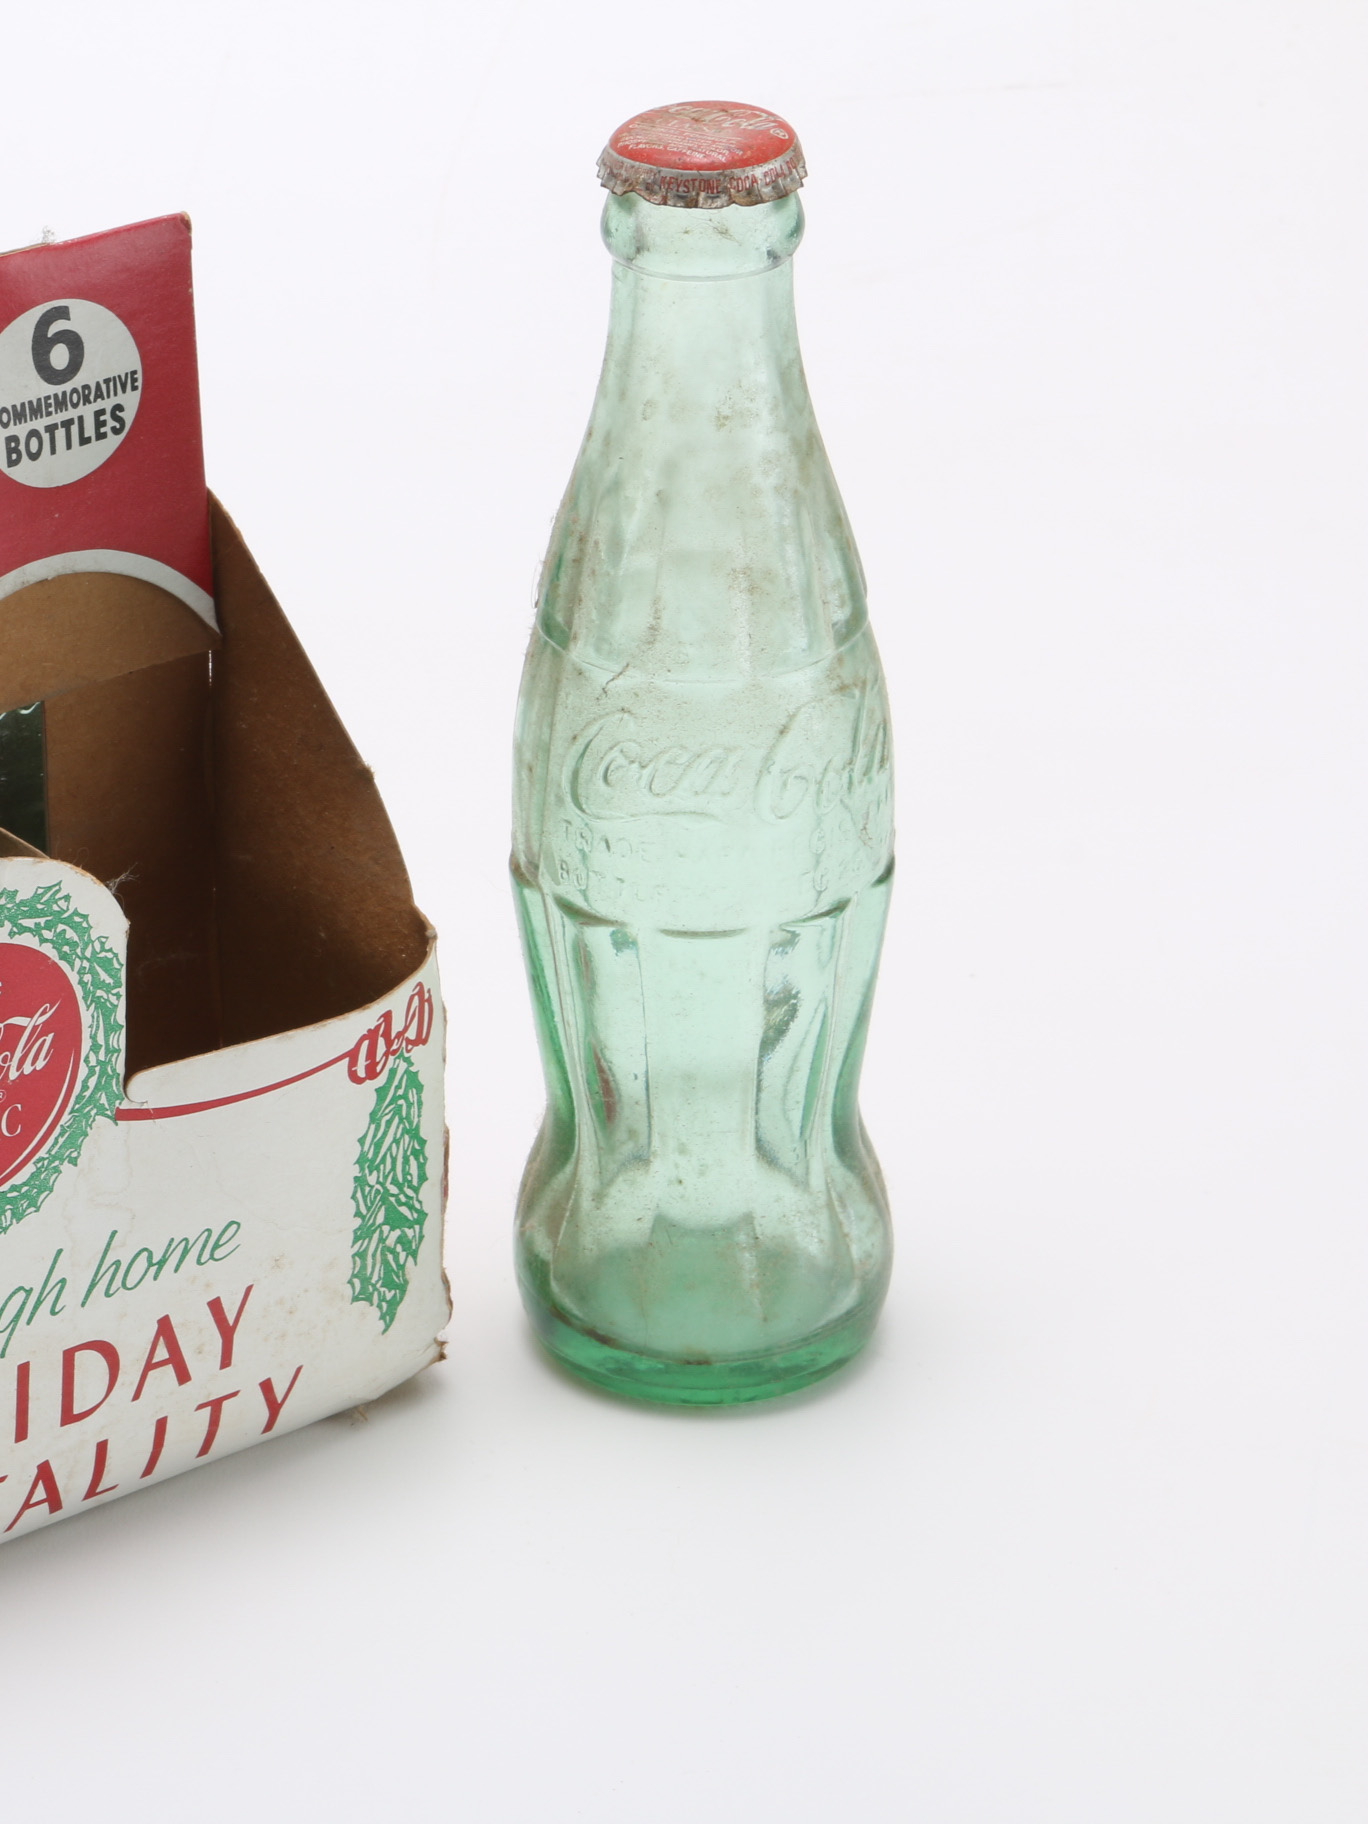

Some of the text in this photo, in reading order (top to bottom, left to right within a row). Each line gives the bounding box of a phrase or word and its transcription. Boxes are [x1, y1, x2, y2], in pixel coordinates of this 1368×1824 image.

[660, 175, 721, 194] KEYSTONE
[31, 305, 85, 386] 6
[4, 403, 127, 469] BOTTLES
[81, 1220, 242, 1308] home
